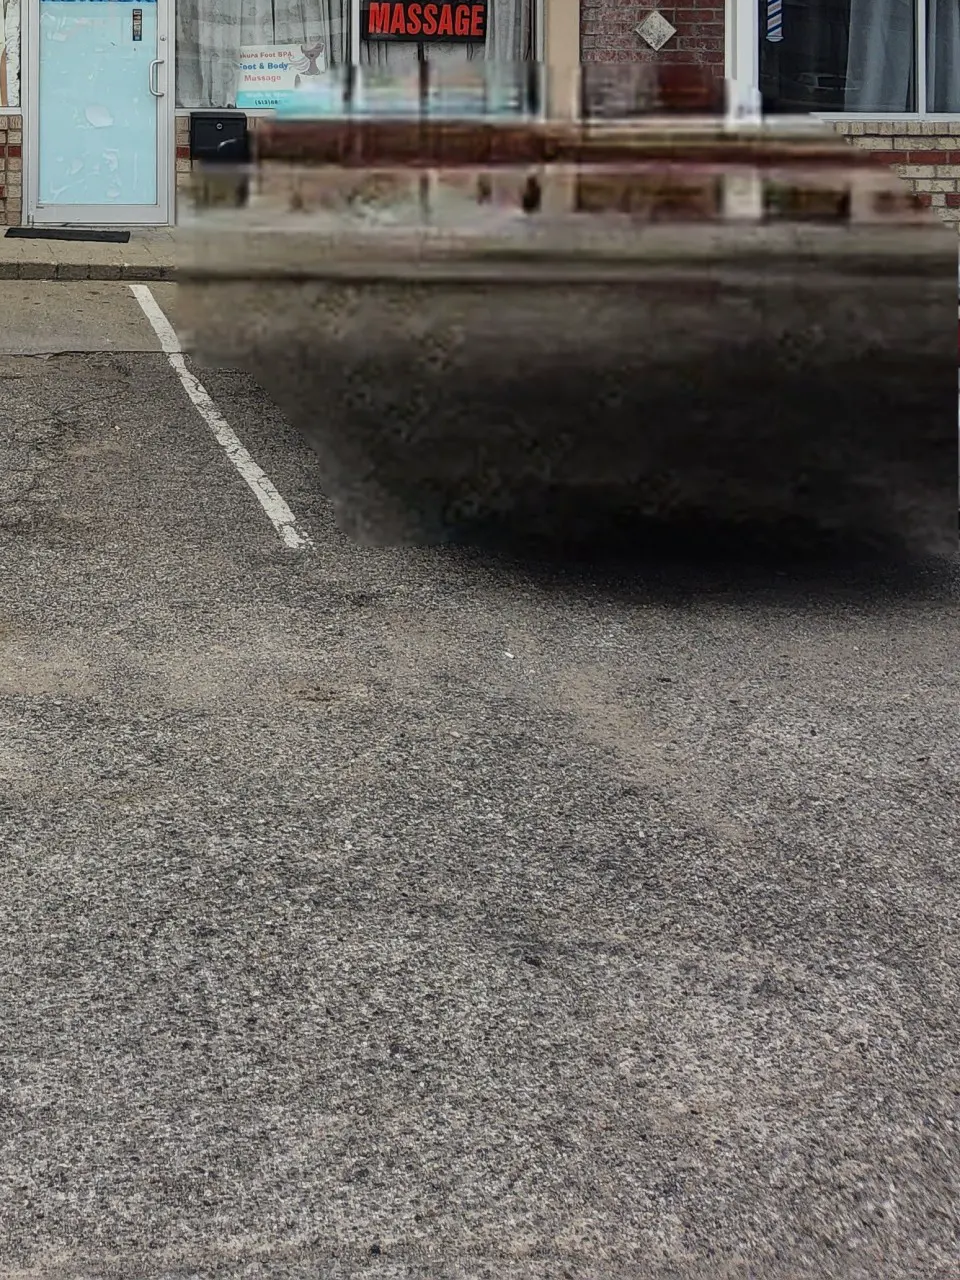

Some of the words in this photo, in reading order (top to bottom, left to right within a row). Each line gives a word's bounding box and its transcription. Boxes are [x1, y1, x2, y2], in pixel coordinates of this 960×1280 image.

[368, 2, 485, 37] MASSAGE
[259, 62, 265, 70] &
[268, 62, 289, 70] Body
